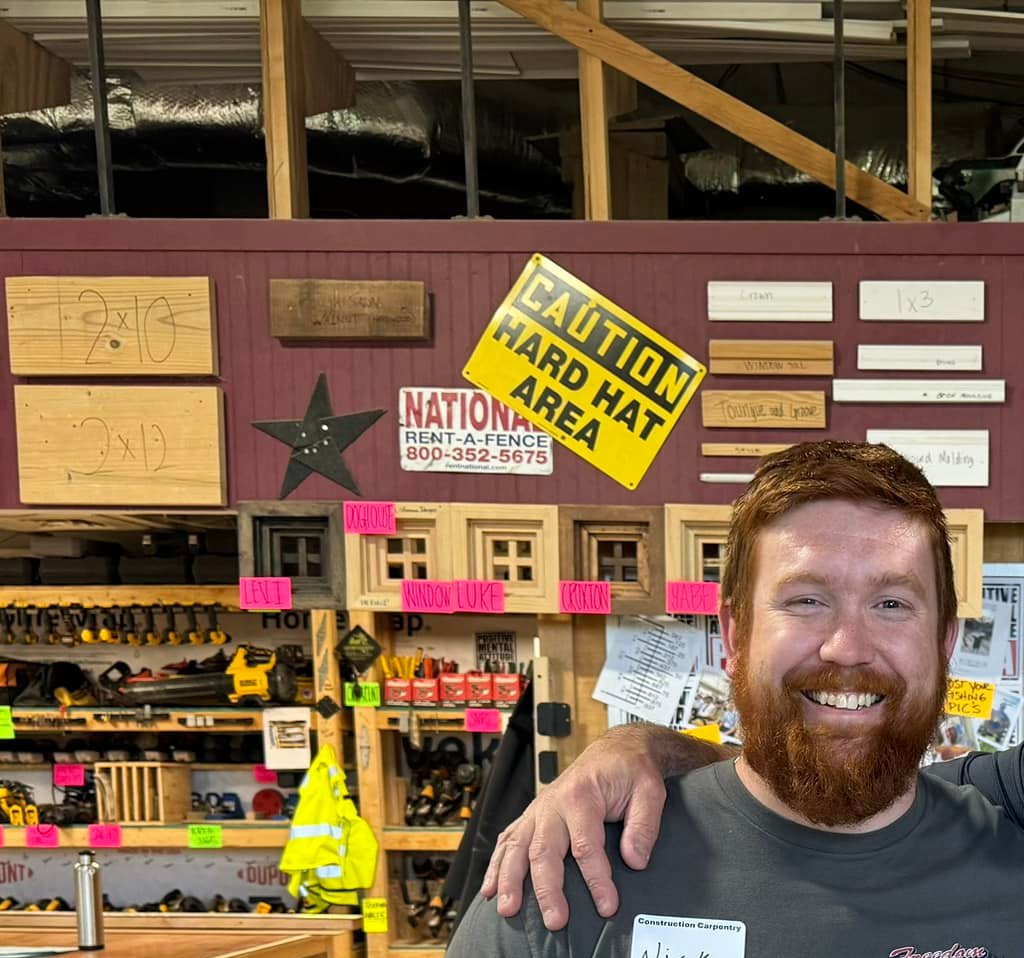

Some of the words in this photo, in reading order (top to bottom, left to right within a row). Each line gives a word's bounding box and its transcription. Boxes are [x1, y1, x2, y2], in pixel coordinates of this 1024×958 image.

[518, 273, 691, 405] CAUTION
[493, 314, 590, 392] HARD
[591, 381, 666, 441] HAT
[510, 375, 601, 452] AREA
[404, 431, 549, 448] RENT-A-FENCE
[405, 446, 549, 465] 800-352-5675
[457, 582, 500, 611] LUKE
[246, 863, 291, 886] DUPO
[638, 917, 696, 929] Construction
[697, 921, 742, 933] Carpentry
